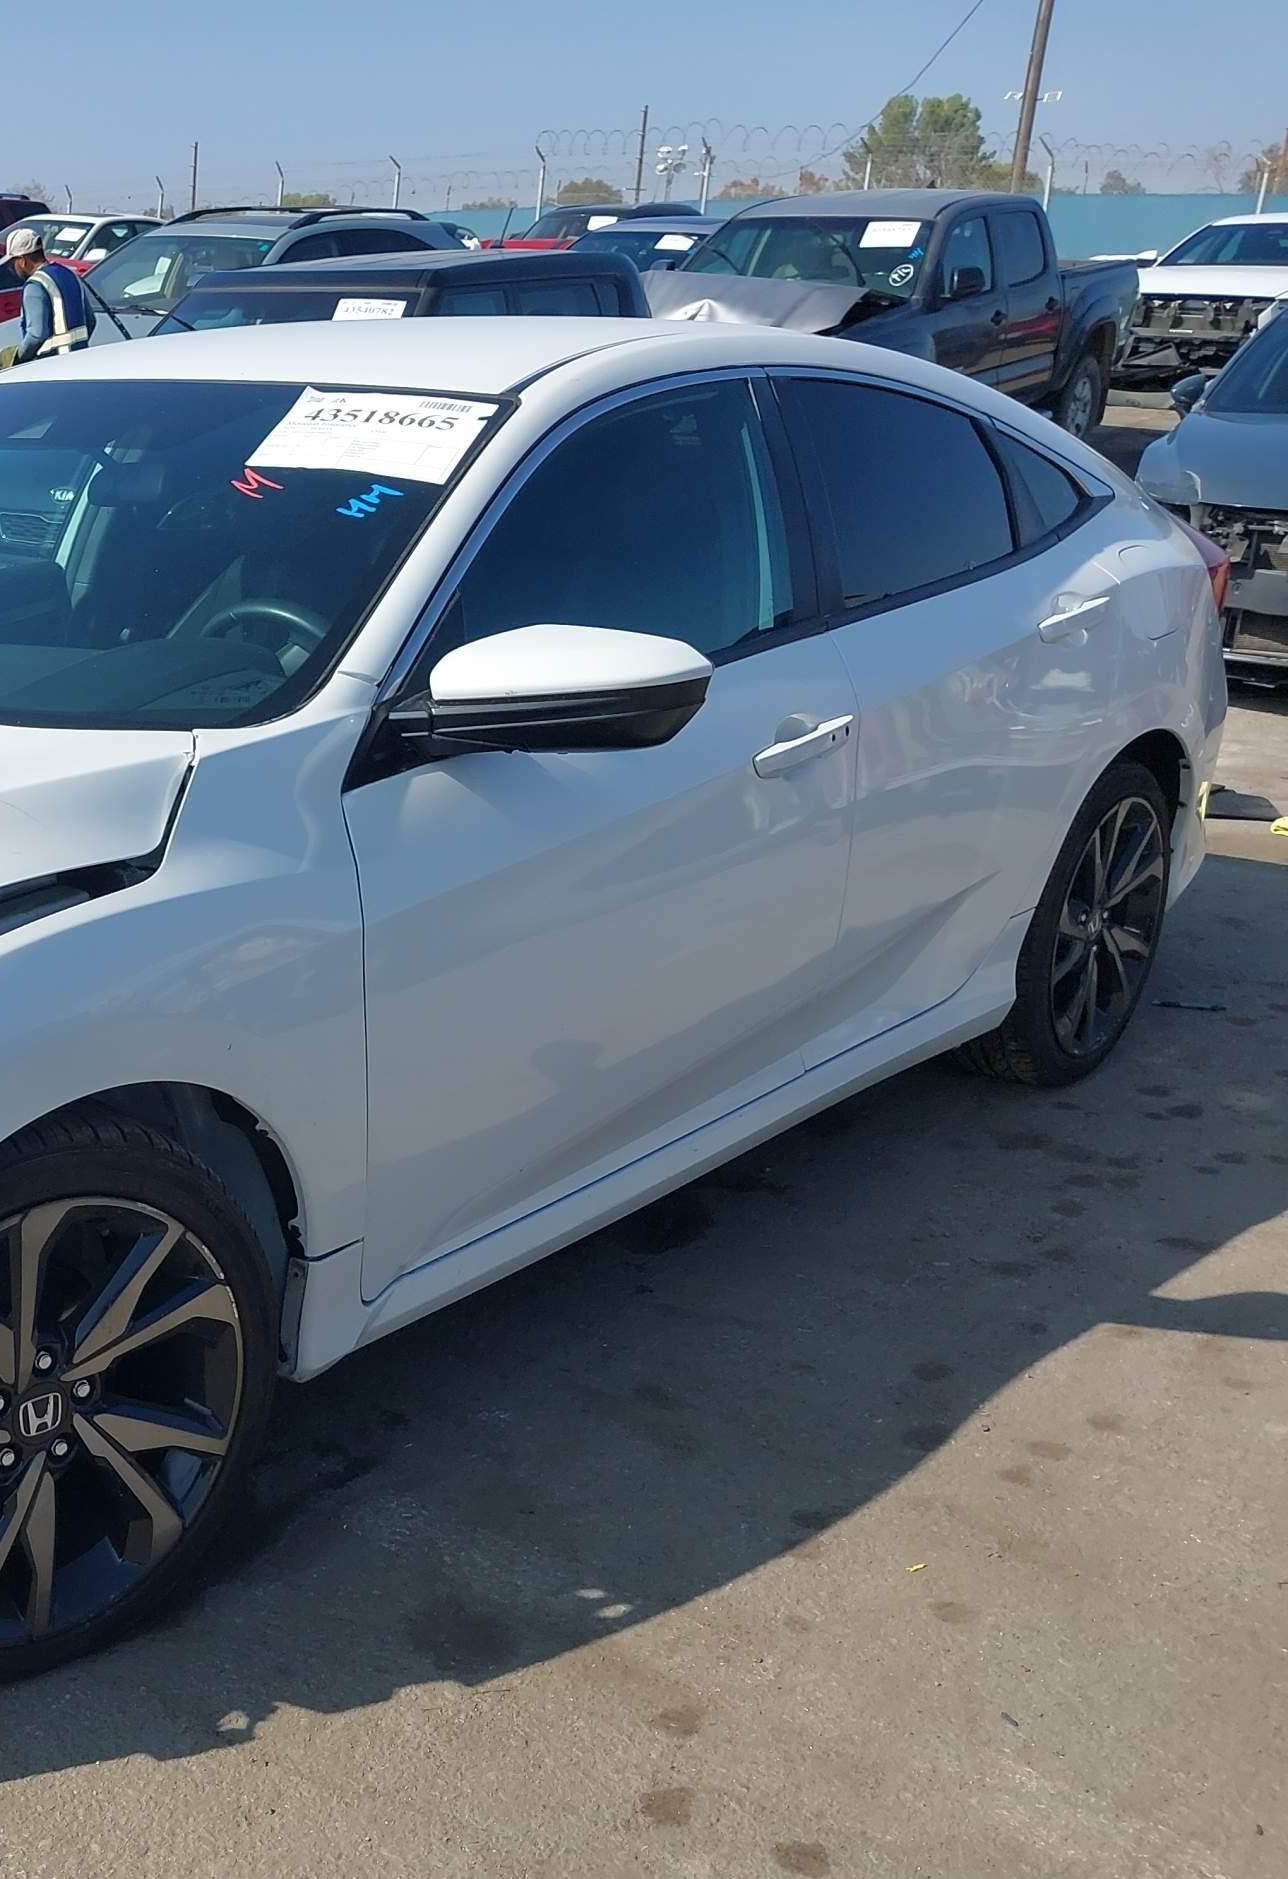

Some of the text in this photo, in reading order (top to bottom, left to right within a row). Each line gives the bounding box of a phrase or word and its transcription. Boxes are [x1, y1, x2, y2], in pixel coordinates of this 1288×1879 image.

[304, 406, 460, 432] 43518665
[54, 489, 75, 501] KIA
[231, 467, 285, 499] M
